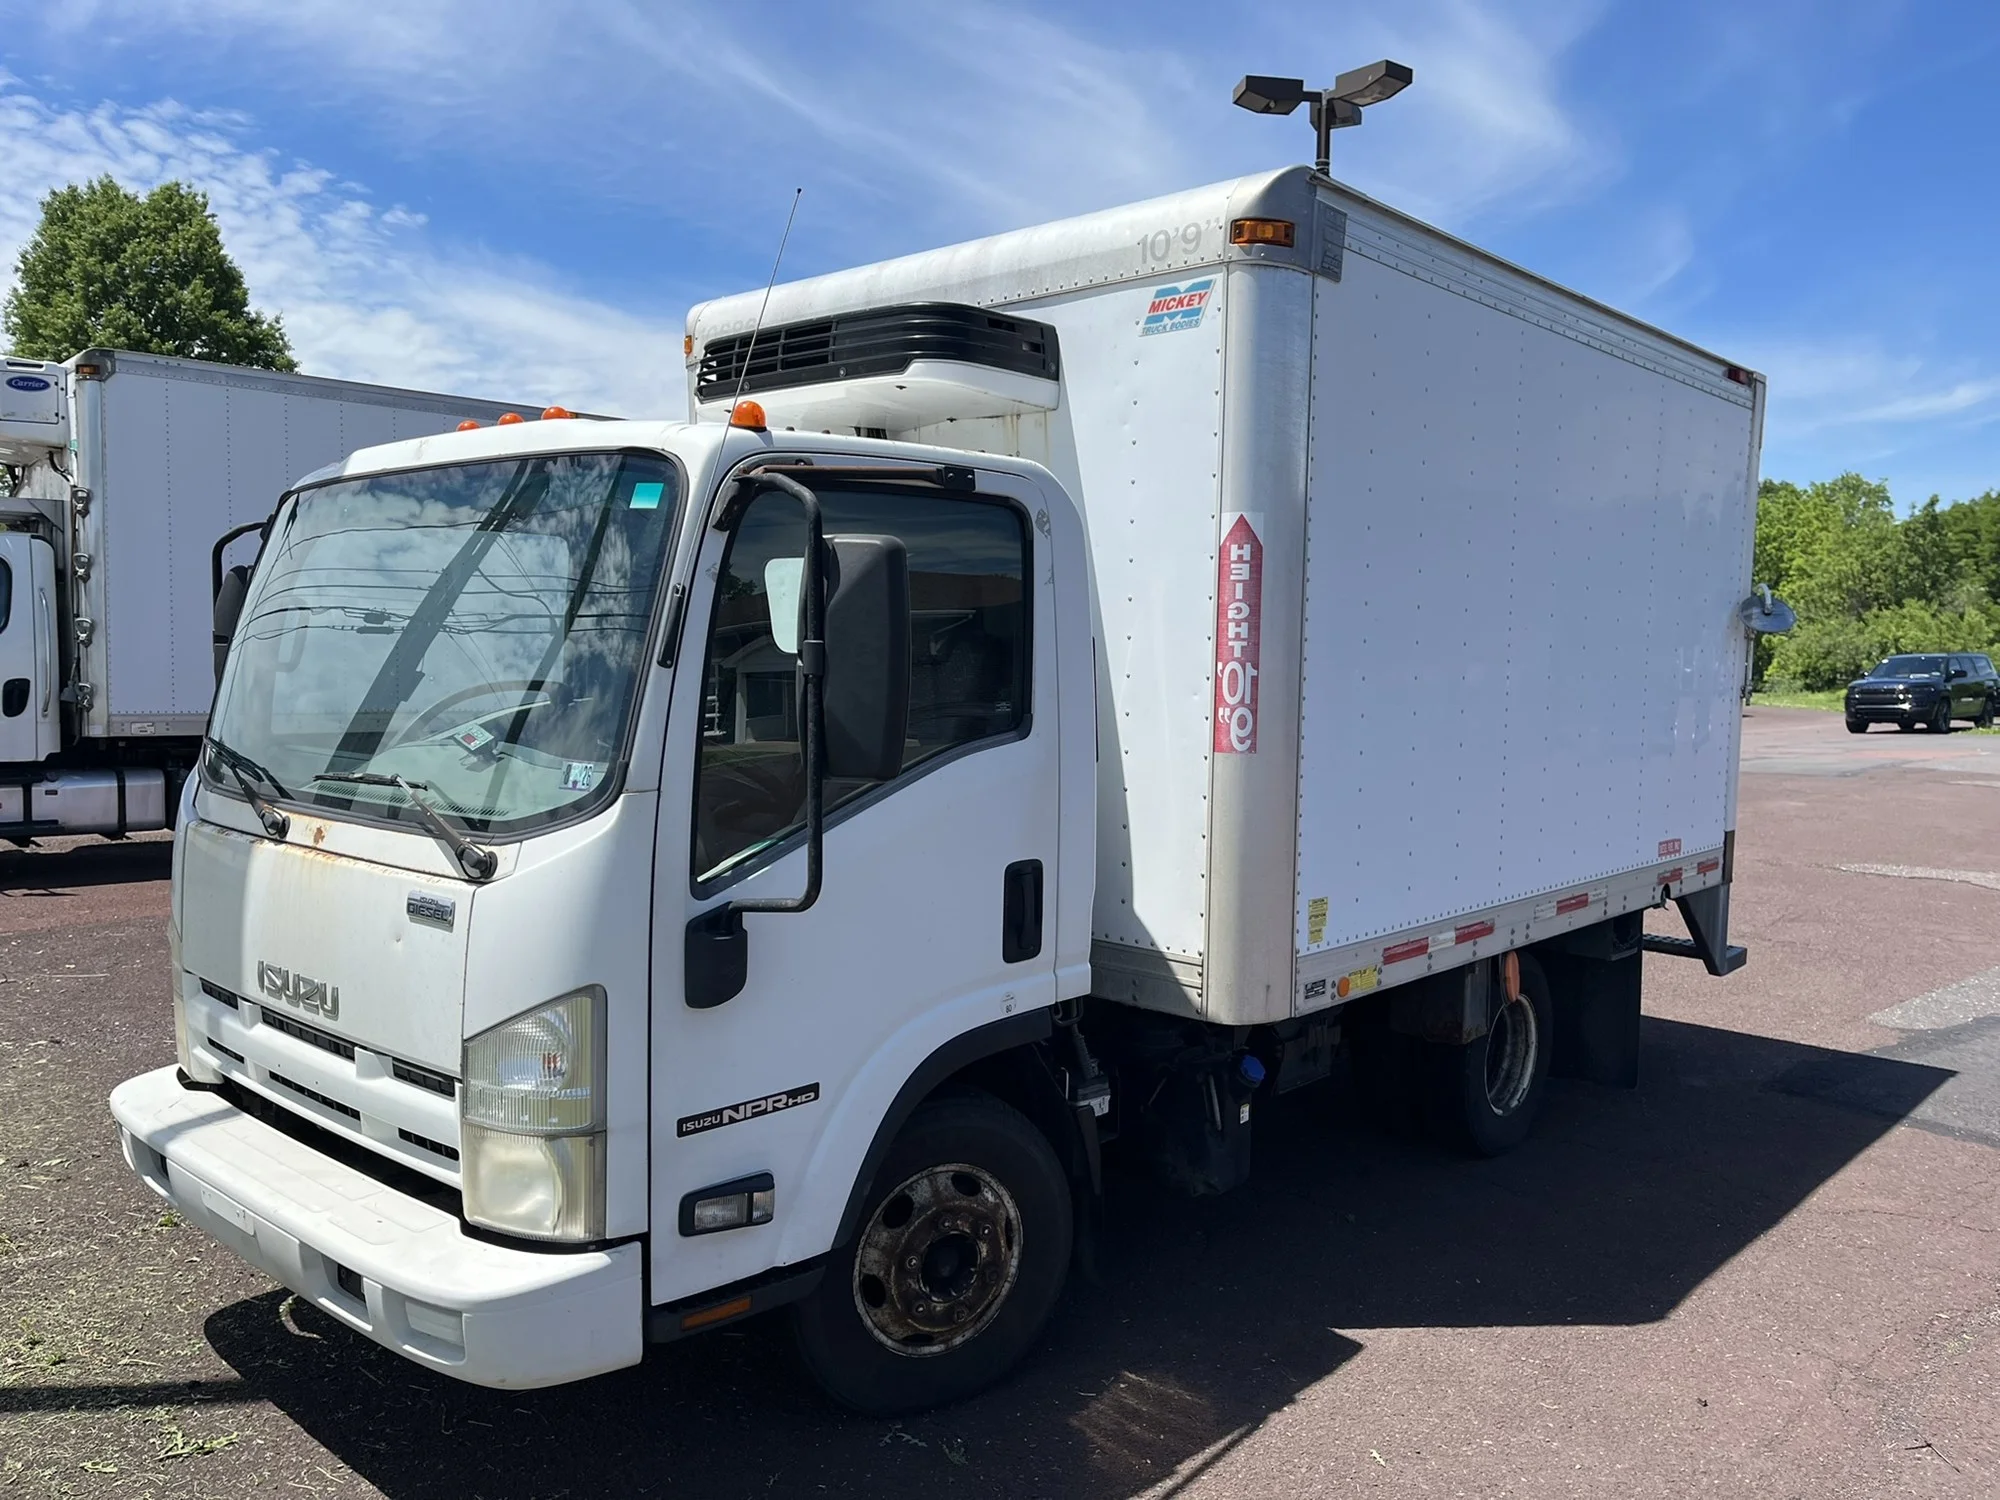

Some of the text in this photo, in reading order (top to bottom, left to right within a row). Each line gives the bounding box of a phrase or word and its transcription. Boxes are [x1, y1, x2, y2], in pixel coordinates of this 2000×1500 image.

[1148, 291, 1208, 314] MICKEY
[1142, 318, 1199, 335] TRUCK BODIES
[11, 379, 46, 388] Carrier
[407, 902, 448, 921] DIESEL
[257, 960, 340, 1020] ISUZU
[682, 1092, 815, 1132] ISUZU NPR HD
